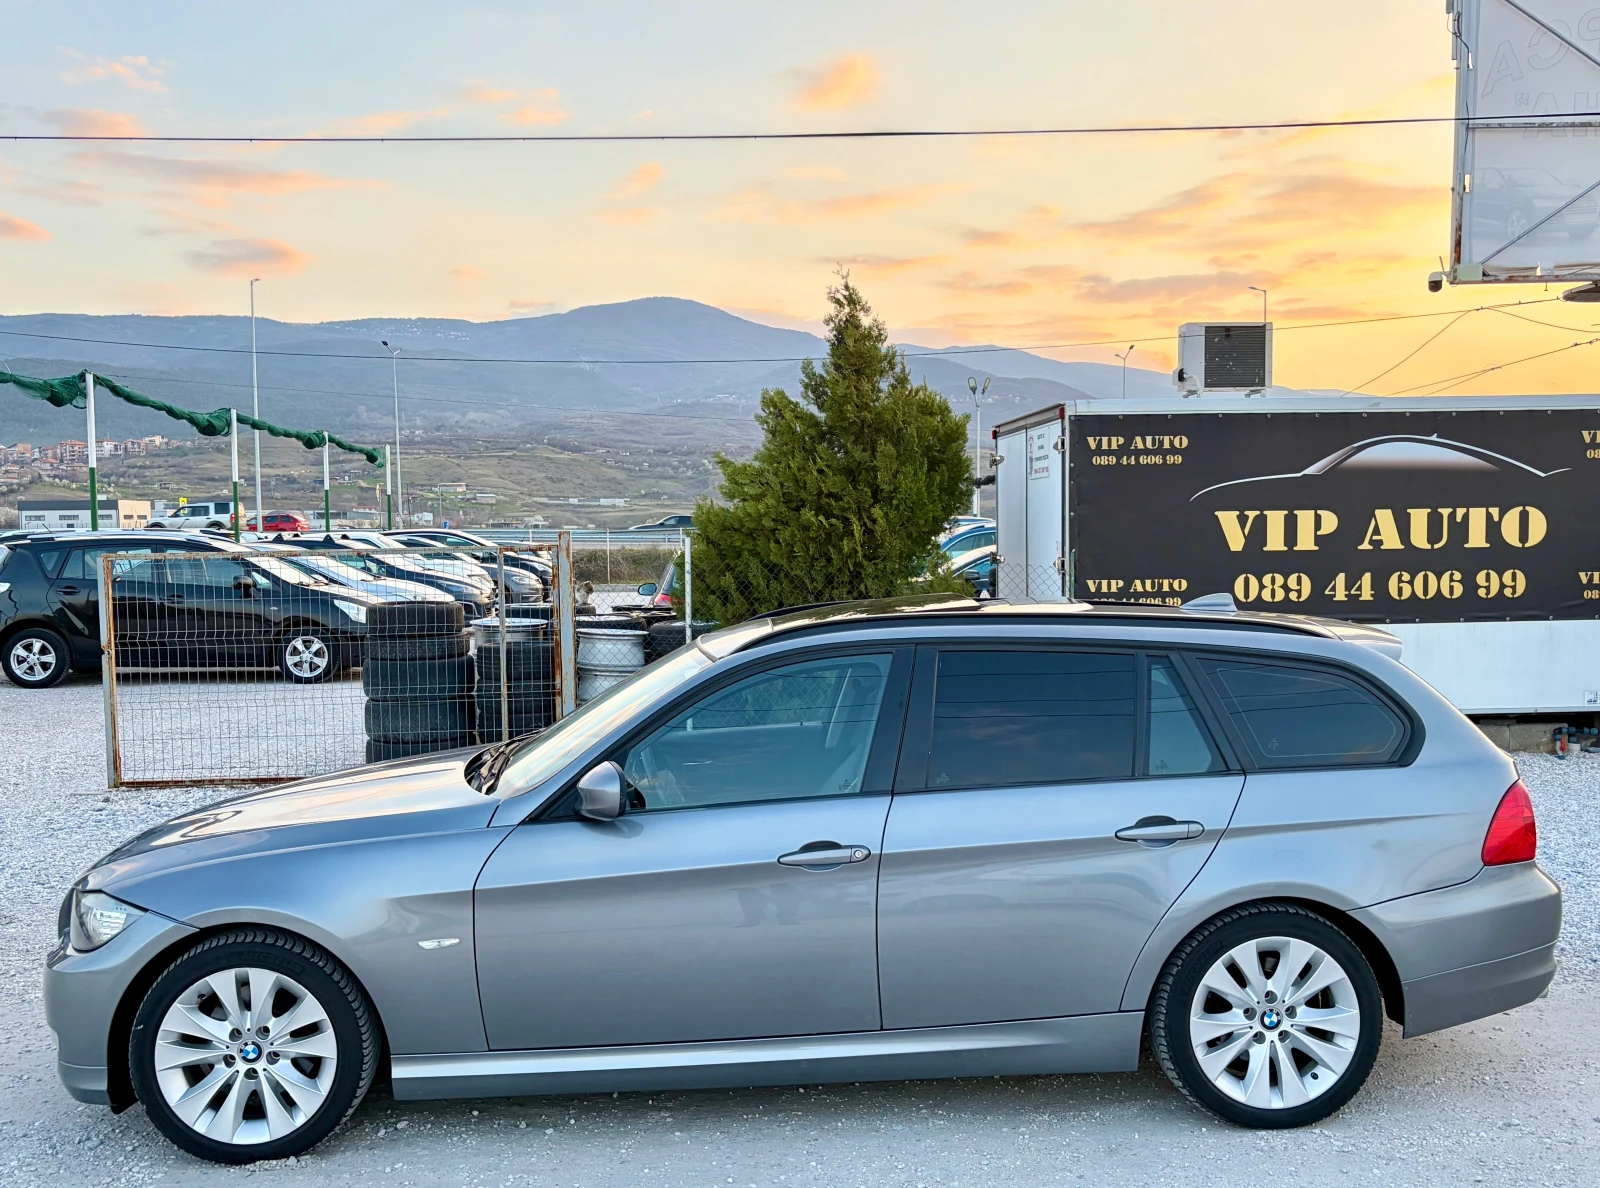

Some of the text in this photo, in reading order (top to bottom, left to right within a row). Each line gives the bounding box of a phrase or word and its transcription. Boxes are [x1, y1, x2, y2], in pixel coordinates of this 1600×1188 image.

[1086, 435, 1189, 450] VIP AUTO
[1092, 454, 1183, 466] 089 44 606 99
[1214, 505, 1548, 552] VIP AUTO
[1086, 578, 1188, 593] VIP AUTO
[1234, 568, 1527, 603] 089 44 606 99
[1166, 596, 1182, 607] 99
